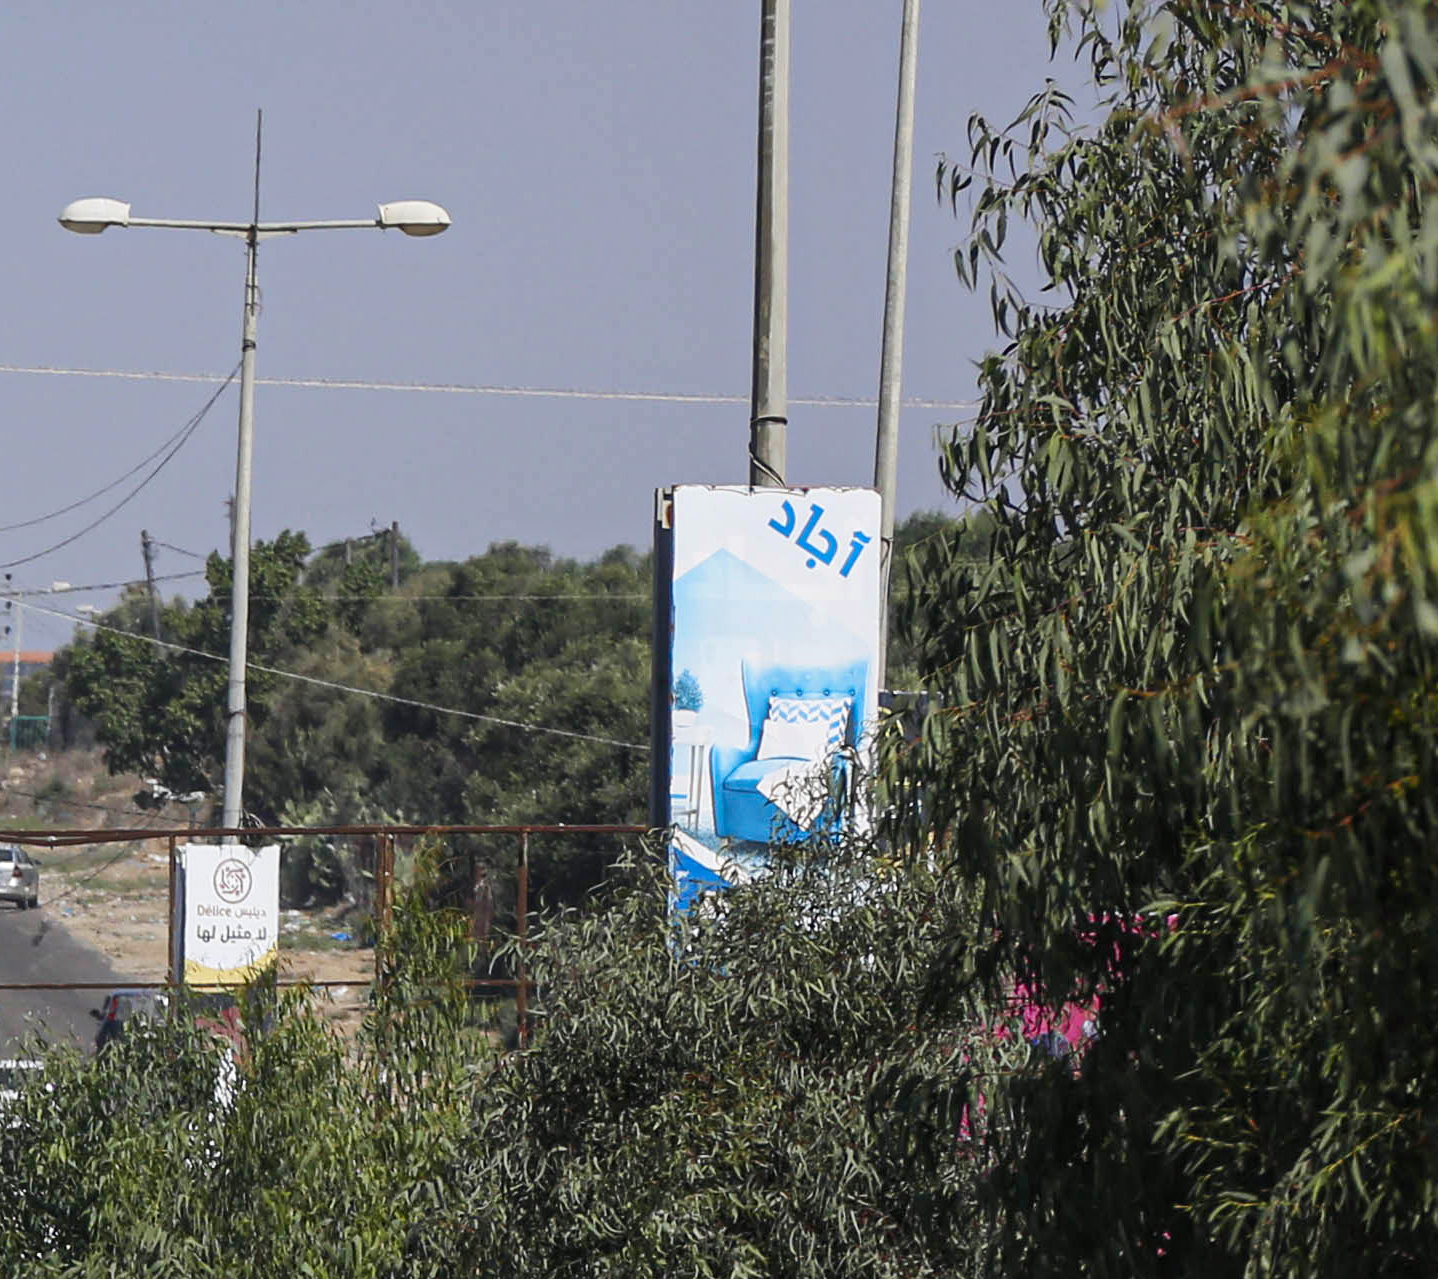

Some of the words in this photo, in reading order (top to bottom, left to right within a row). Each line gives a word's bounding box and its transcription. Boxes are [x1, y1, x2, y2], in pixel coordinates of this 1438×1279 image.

[768, 500, 872, 578] آجاد
[197, 904, 231, 917] Délice
[197, 924, 216, 942] لها
[220, 924, 252, 943] مثيل
